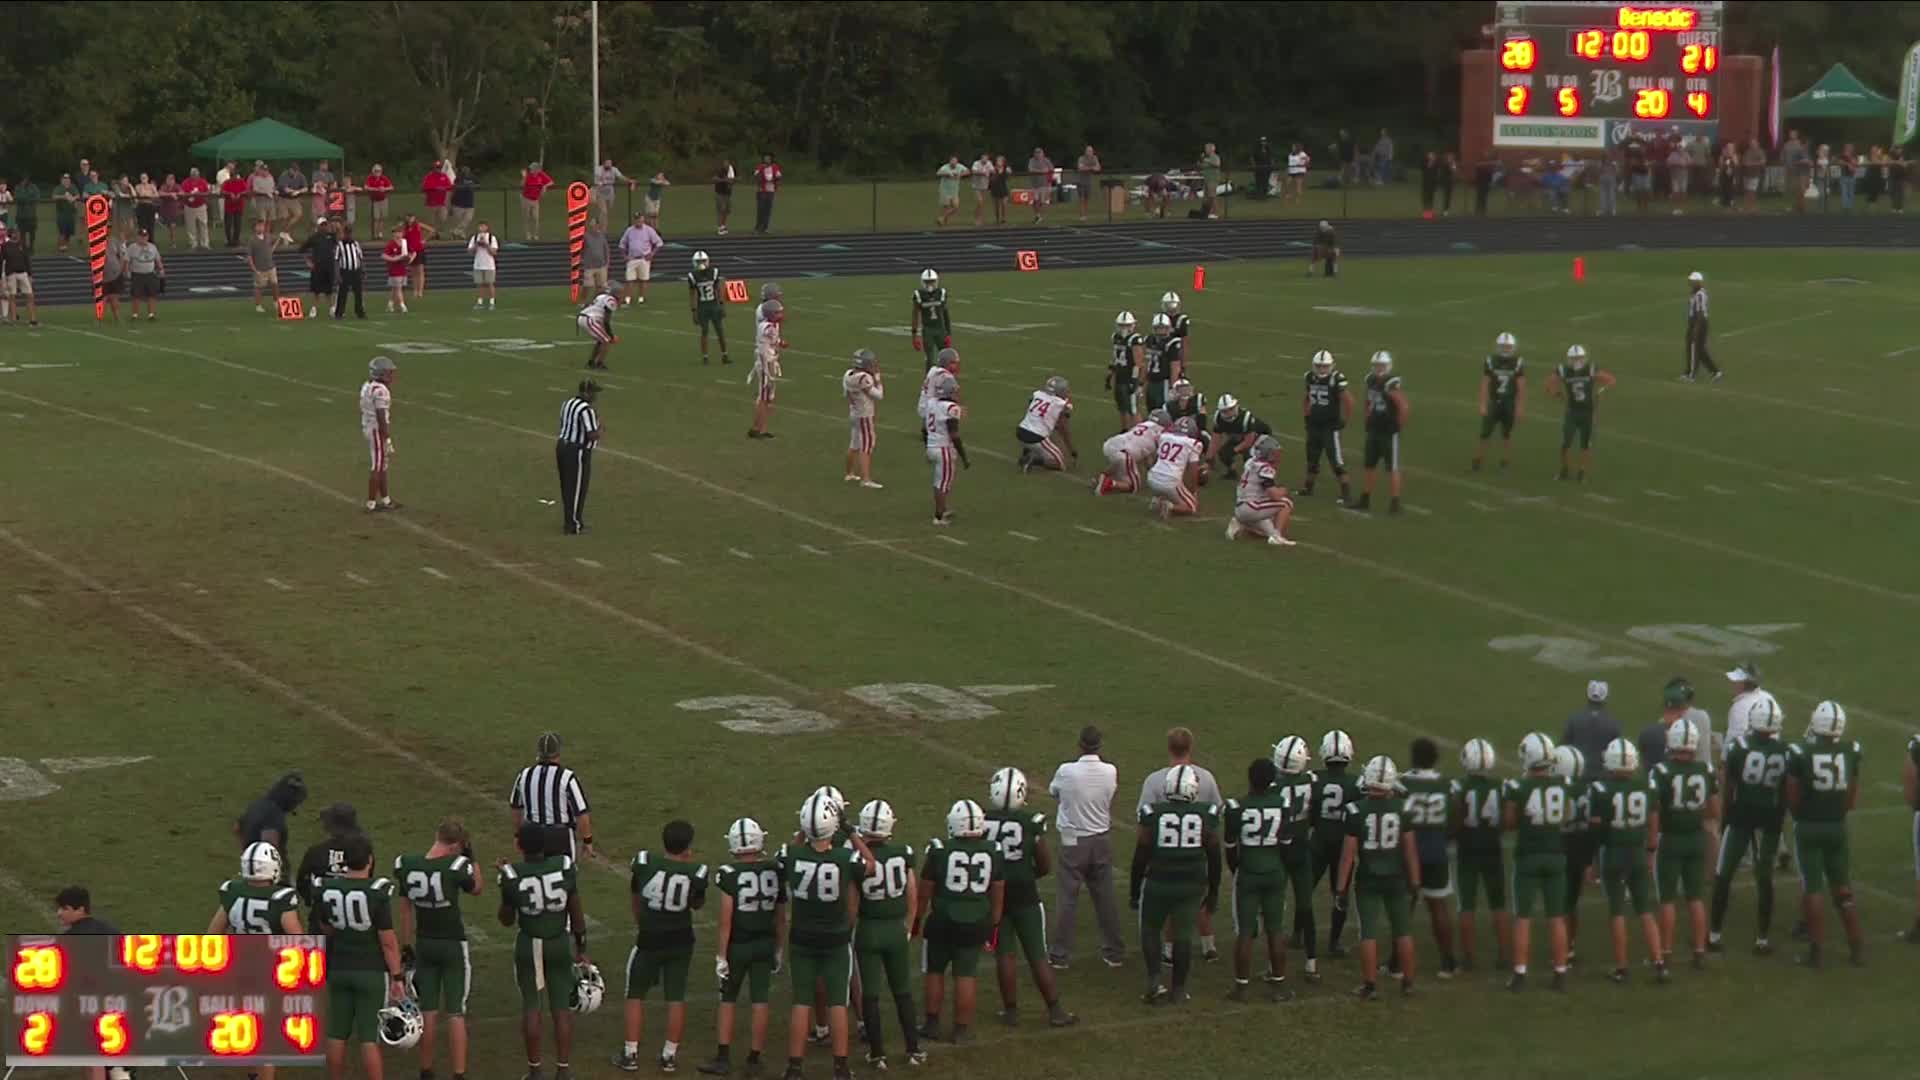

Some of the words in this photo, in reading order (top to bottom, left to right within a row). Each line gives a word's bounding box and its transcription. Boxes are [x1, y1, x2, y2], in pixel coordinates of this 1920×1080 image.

[1617, 6, 1698, 30] Benedic
[1501, 38, 1536, 71] 28
[1575, 29, 1650, 60] 12:00
[1676, 31, 1718, 46] GUEST
[1681, 42, 1717, 75] 21
[1506, 85, 1527, 116] 2
[1557, 86, 1578, 117] 5
[1634, 88, 1668, 119] 20
[1687, 90, 1708, 119] 4
[1022, 253, 1036, 268] G
[281, 300, 300, 316] 20
[699, 284, 715, 301] 12
[729, 282, 745, 299] 10
[929, 305, 938, 320] 1
[1029, 398, 1051, 417] 74
[1160, 441, 1183, 463] 97
[676, 682, 1004, 736] 30
[1743, 751, 1786, 786] 82
[1811, 753, 1849, 791] 51
[1463, 789, 1500, 828] 14
[1525, 786, 1565, 825] 48
[1611, 792, 1648, 828] 19
[1672, 774, 1707, 810] 13
[984, 819, 1023, 861] 72
[1158, 813, 1203, 849] 68
[1240, 807, 1282, 847] 27
[1363, 813, 1400, 850] 18
[407, 870, 451, 908] 21
[794, 860, 840, 902] 78
[862, 856, 907, 901] 20
[945, 850, 992, 894] 63
[518, 871, 568, 916] 35
[642, 870, 691, 913] 40
[737, 870, 780, 912] 29
[228, 898, 271, 934] 45
[322, 889, 373, 932] 30
